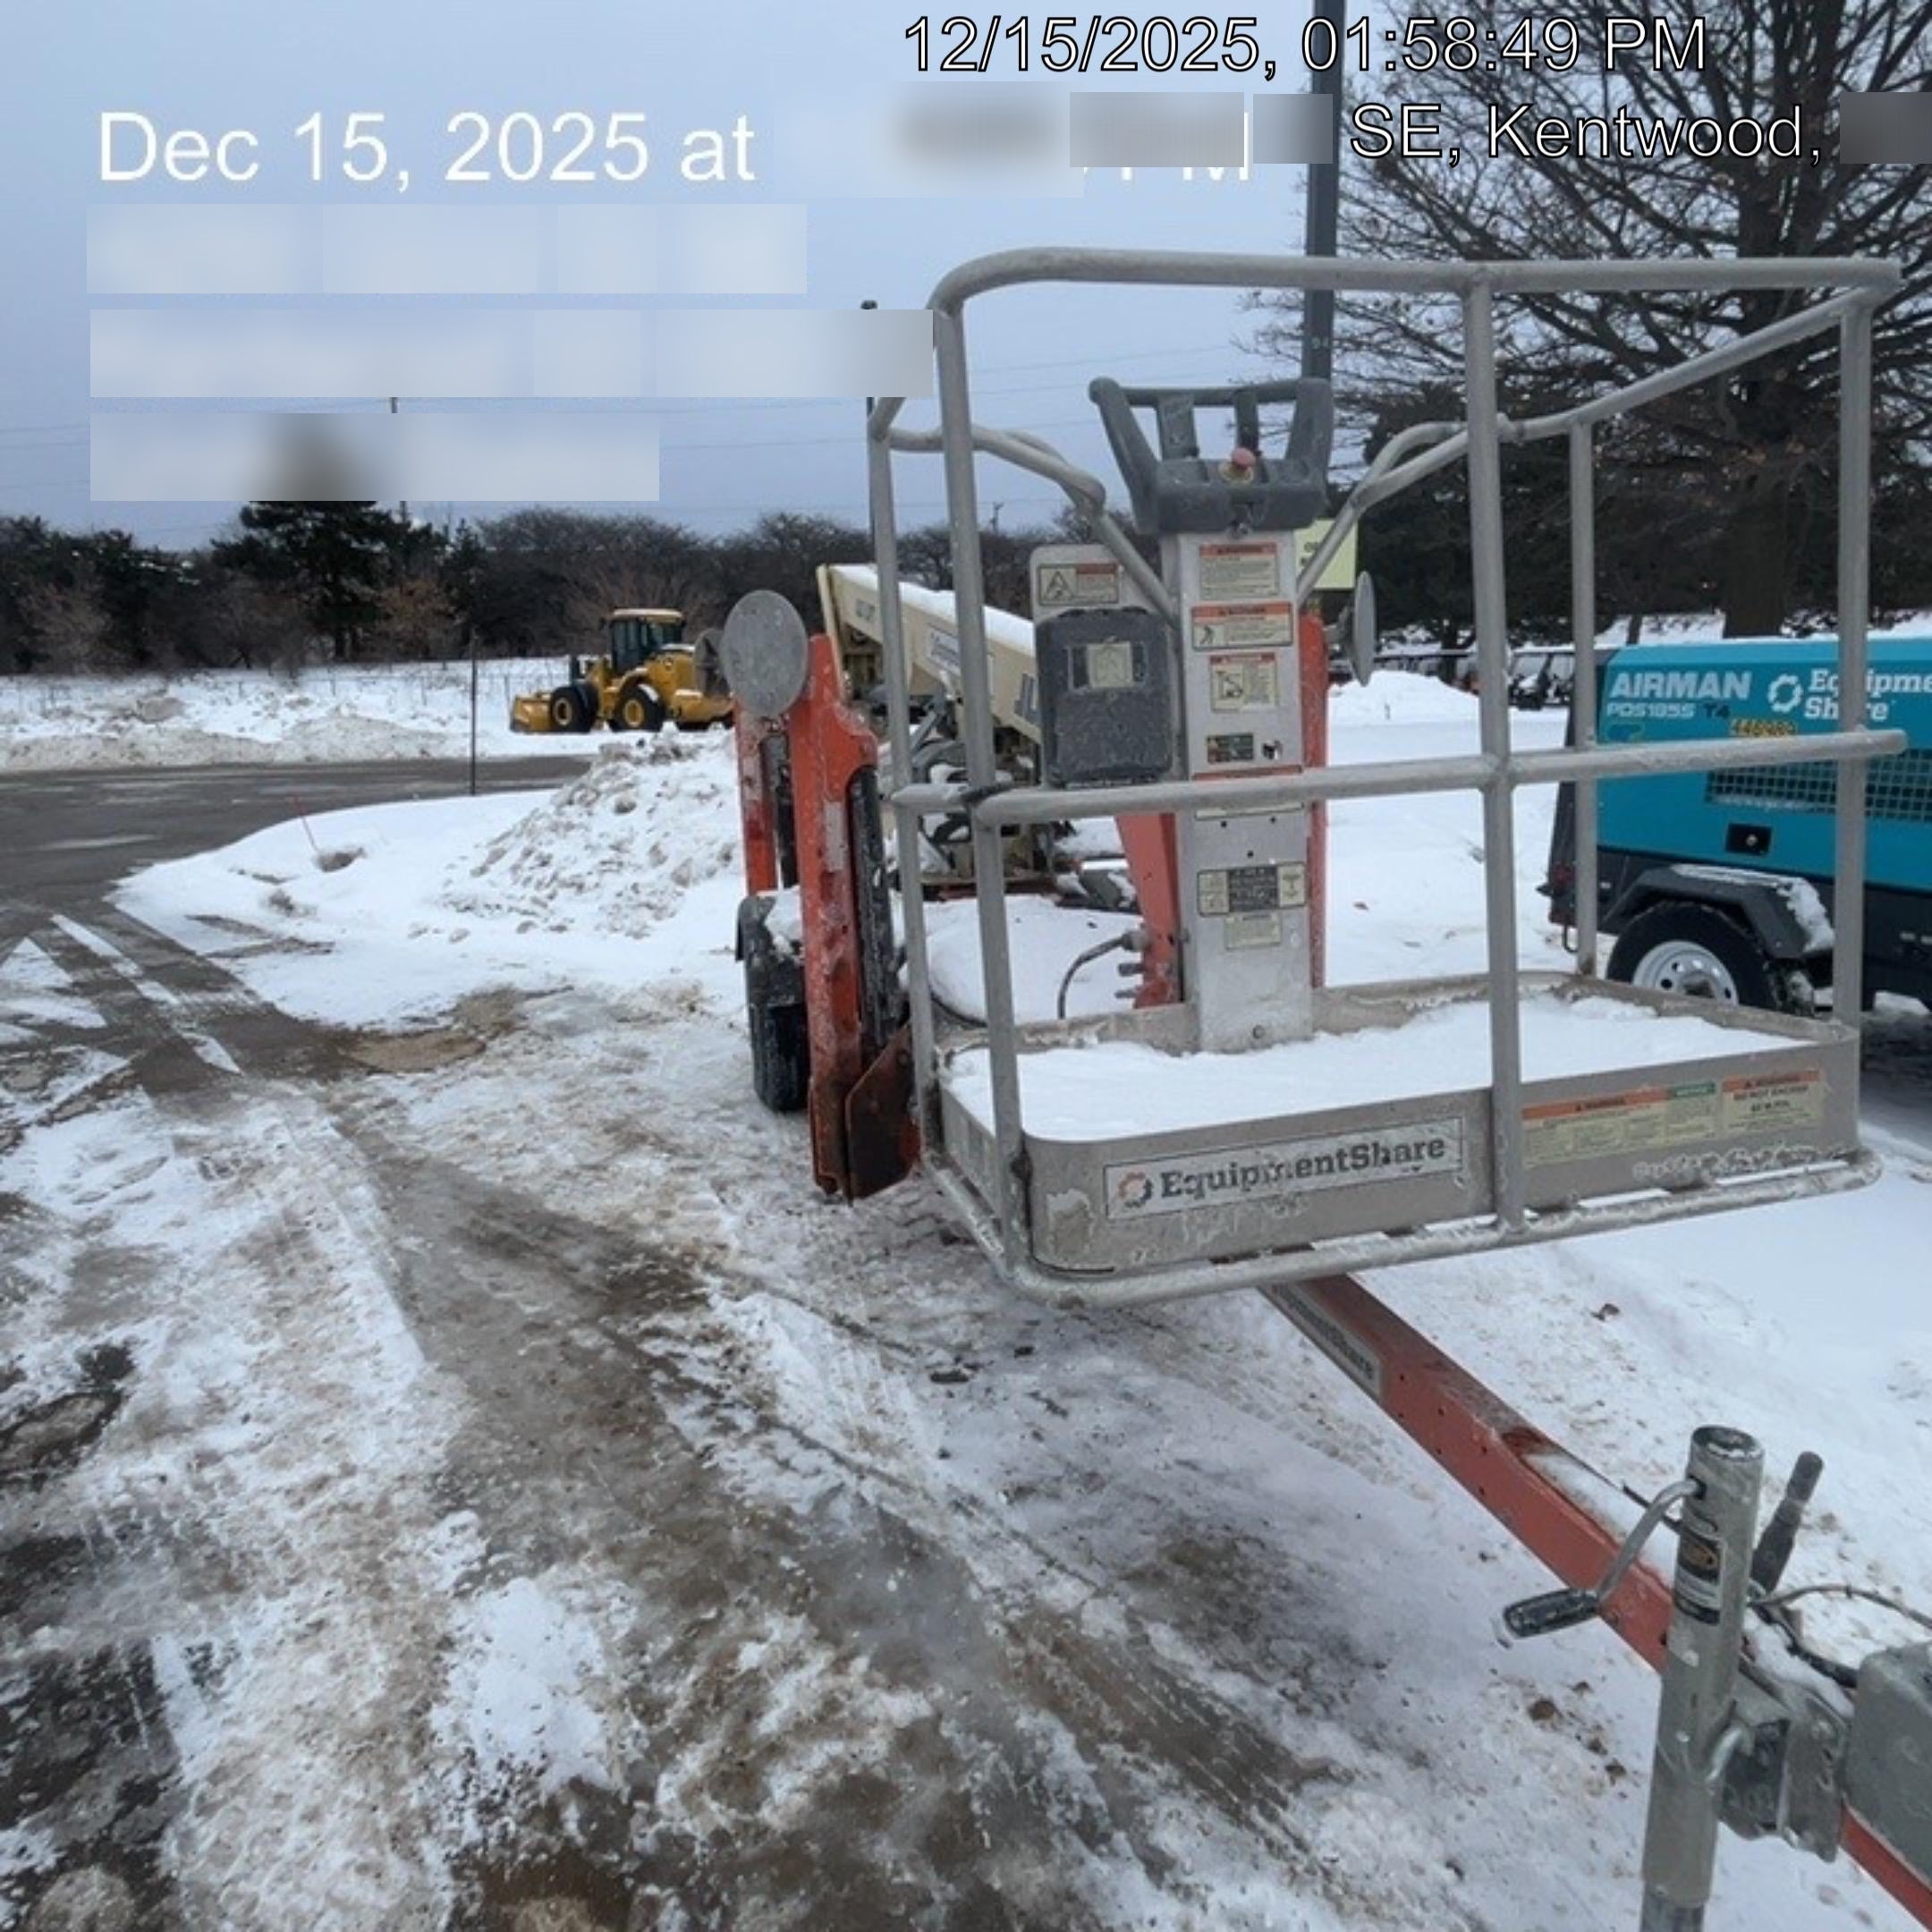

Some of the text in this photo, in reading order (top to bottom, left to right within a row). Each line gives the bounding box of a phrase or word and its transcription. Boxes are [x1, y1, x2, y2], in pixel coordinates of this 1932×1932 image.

[1609, 671, 1753, 701] AIRMAN
[1808, 667, 1932, 699] Eqipme
[1804, 695, 1889, 722] She
